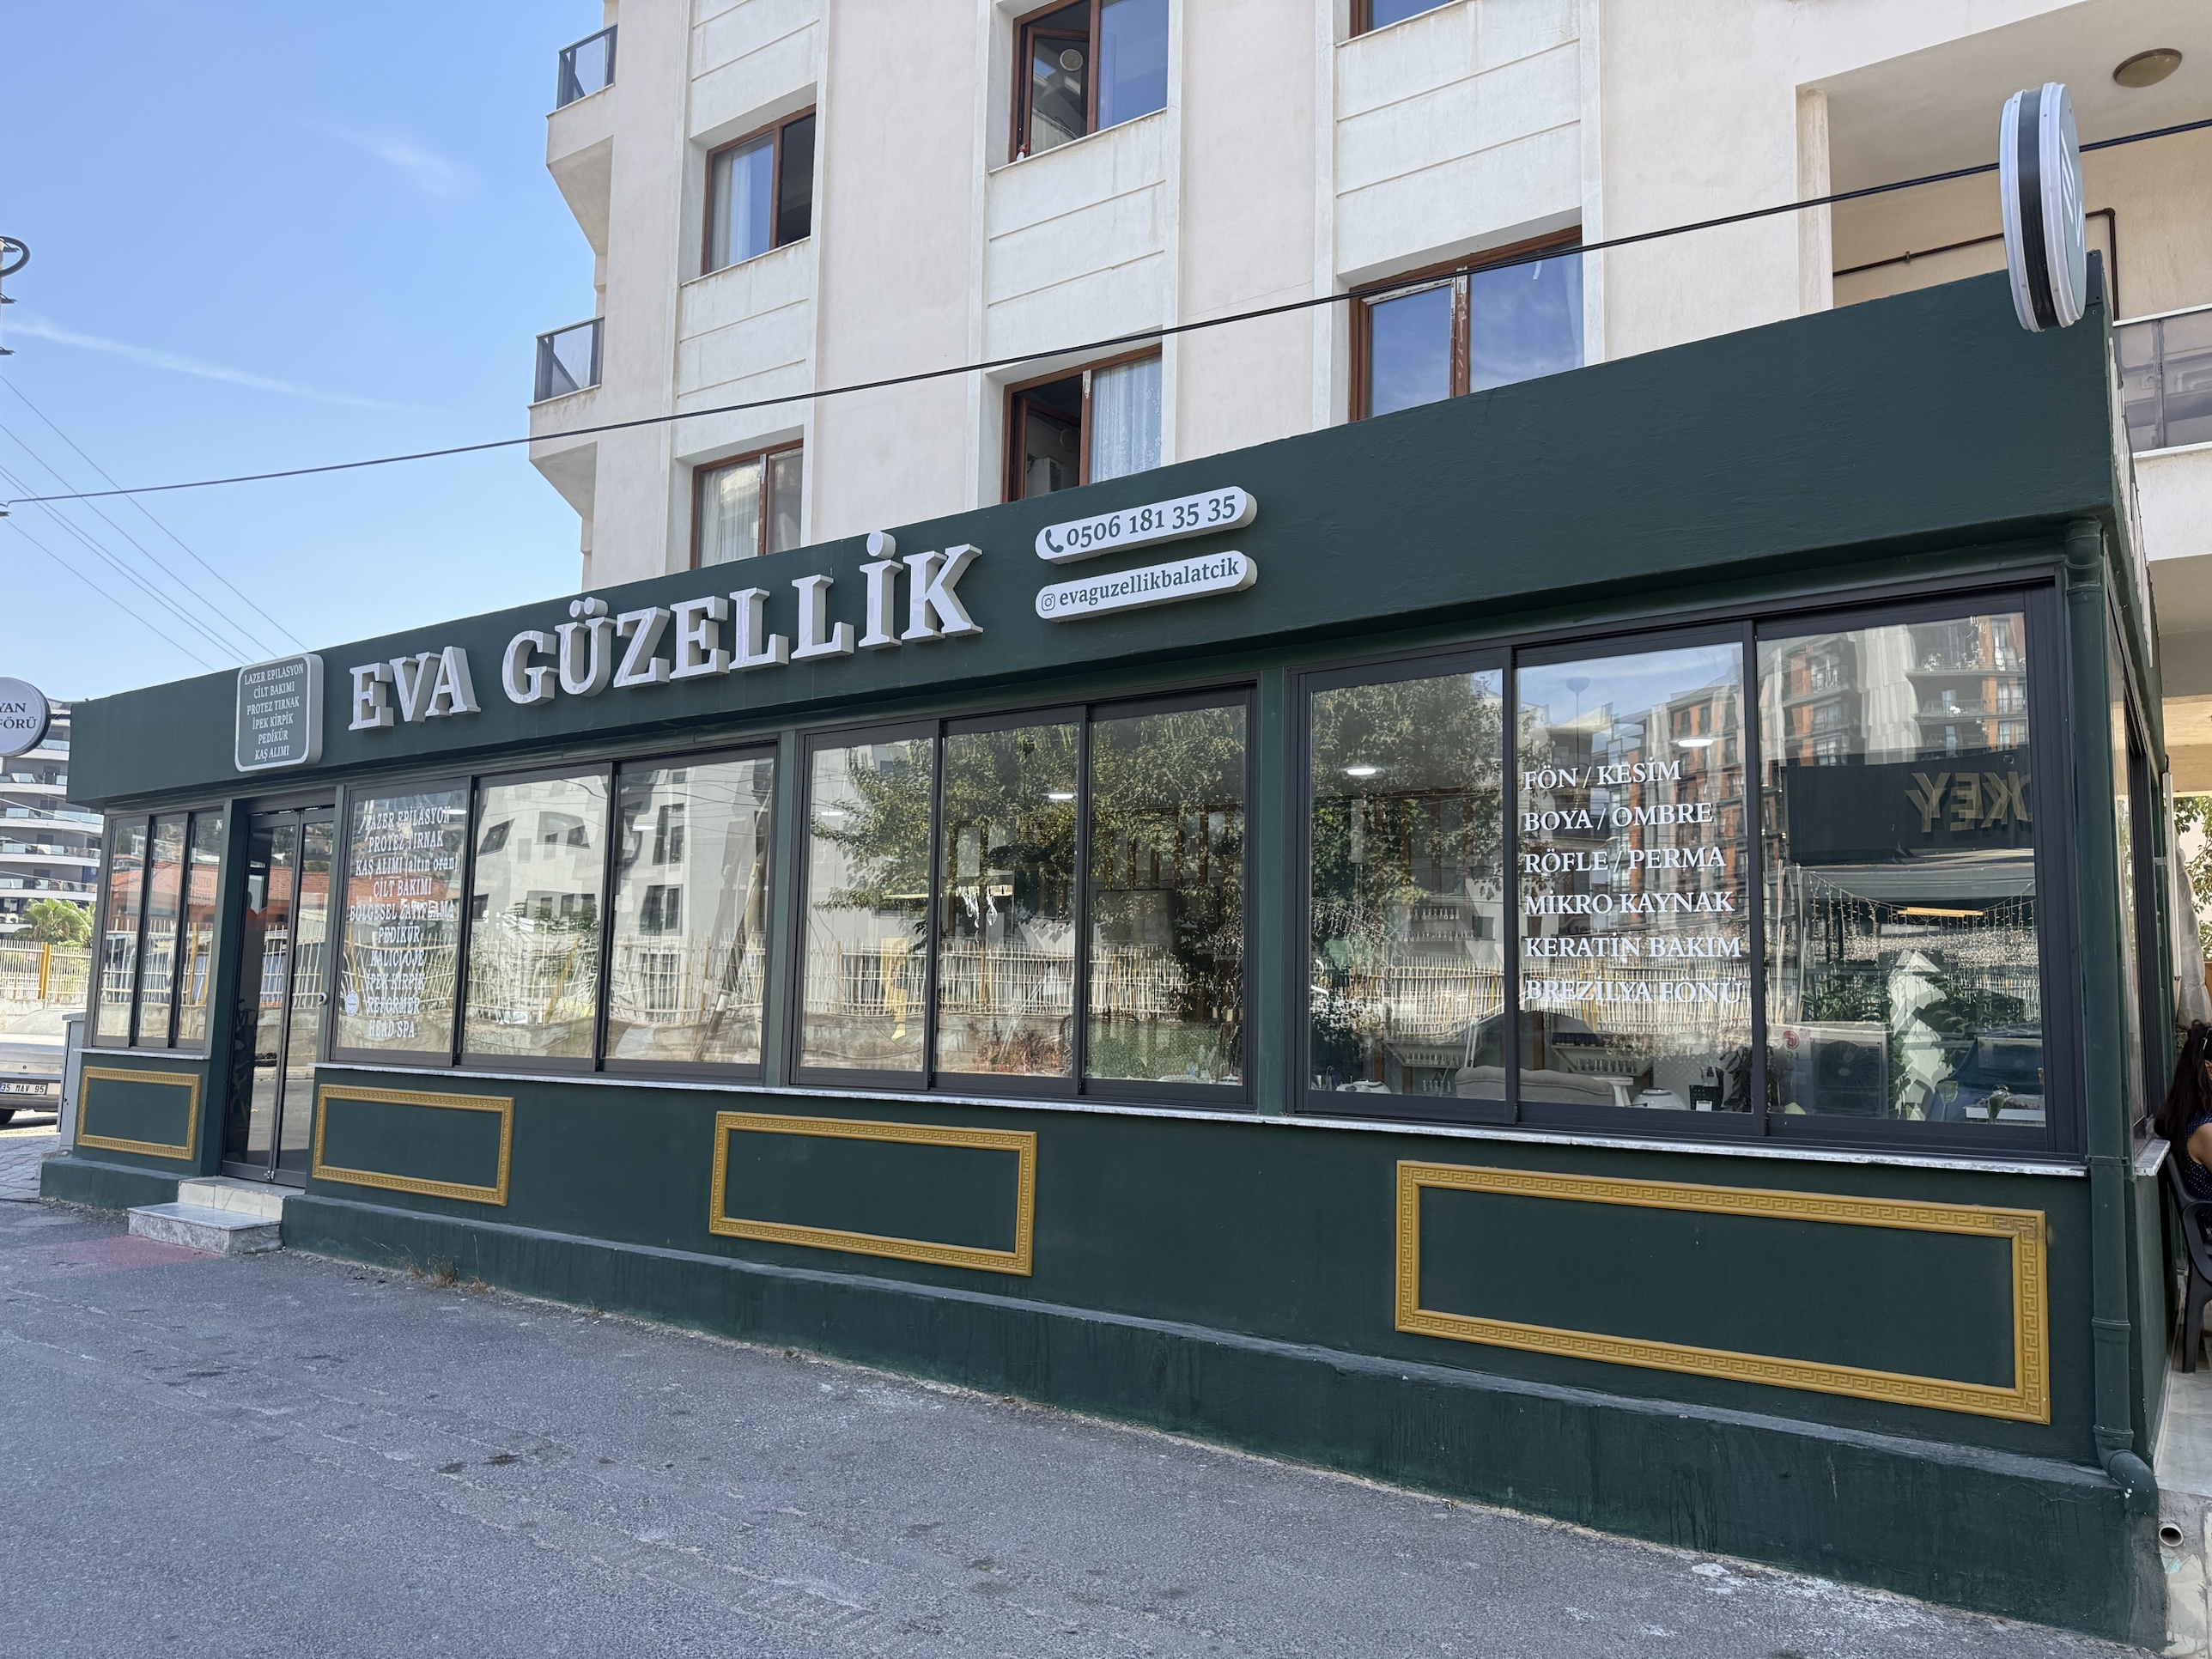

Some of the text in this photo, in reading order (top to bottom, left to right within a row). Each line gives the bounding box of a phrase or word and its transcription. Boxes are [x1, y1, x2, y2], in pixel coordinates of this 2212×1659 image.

[1066, 495, 1236, 548] 0506 181 35 35
[1060, 557, 1239, 605] evaguzellikbalatcik
[348, 530, 983, 732] EVA GÜZELLİK
[244, 673, 266, 685] LAZER
[253, 681, 295, 699] CİLT BAKIMI
[246, 696, 300, 716] PROTEZ TIRNAK
[252, 711, 294, 730] İPEK KİRPİK
[258, 728, 289, 744] PEDİKÜR
[254, 745, 289, 762] KAŞ ALIMI
[1523, 757, 1681, 790] FÖN / KESİM
[1523, 802, 1714, 831] BOYA / OMBRE
[368, 830, 445, 853] PROTEZ TIRNAK
[355, 859, 374, 880] KAŞ
[375, 856, 403, 875] ALIMI
[1524, 846, 1727, 872] RÖFLE / PERMA
[373, 877, 433, 897] CİLT BAKIMI
[1524, 889, 1736, 915] MİKRO KAYNAK
[378, 922, 421, 944] PEDİKÜR
[1524, 932, 1742, 957] KERATİN BAKIM
[1526, 975, 1744, 1004] BREZİLYA FÖNÜ
[368, 1020, 416, 1038] HEAD SPA
